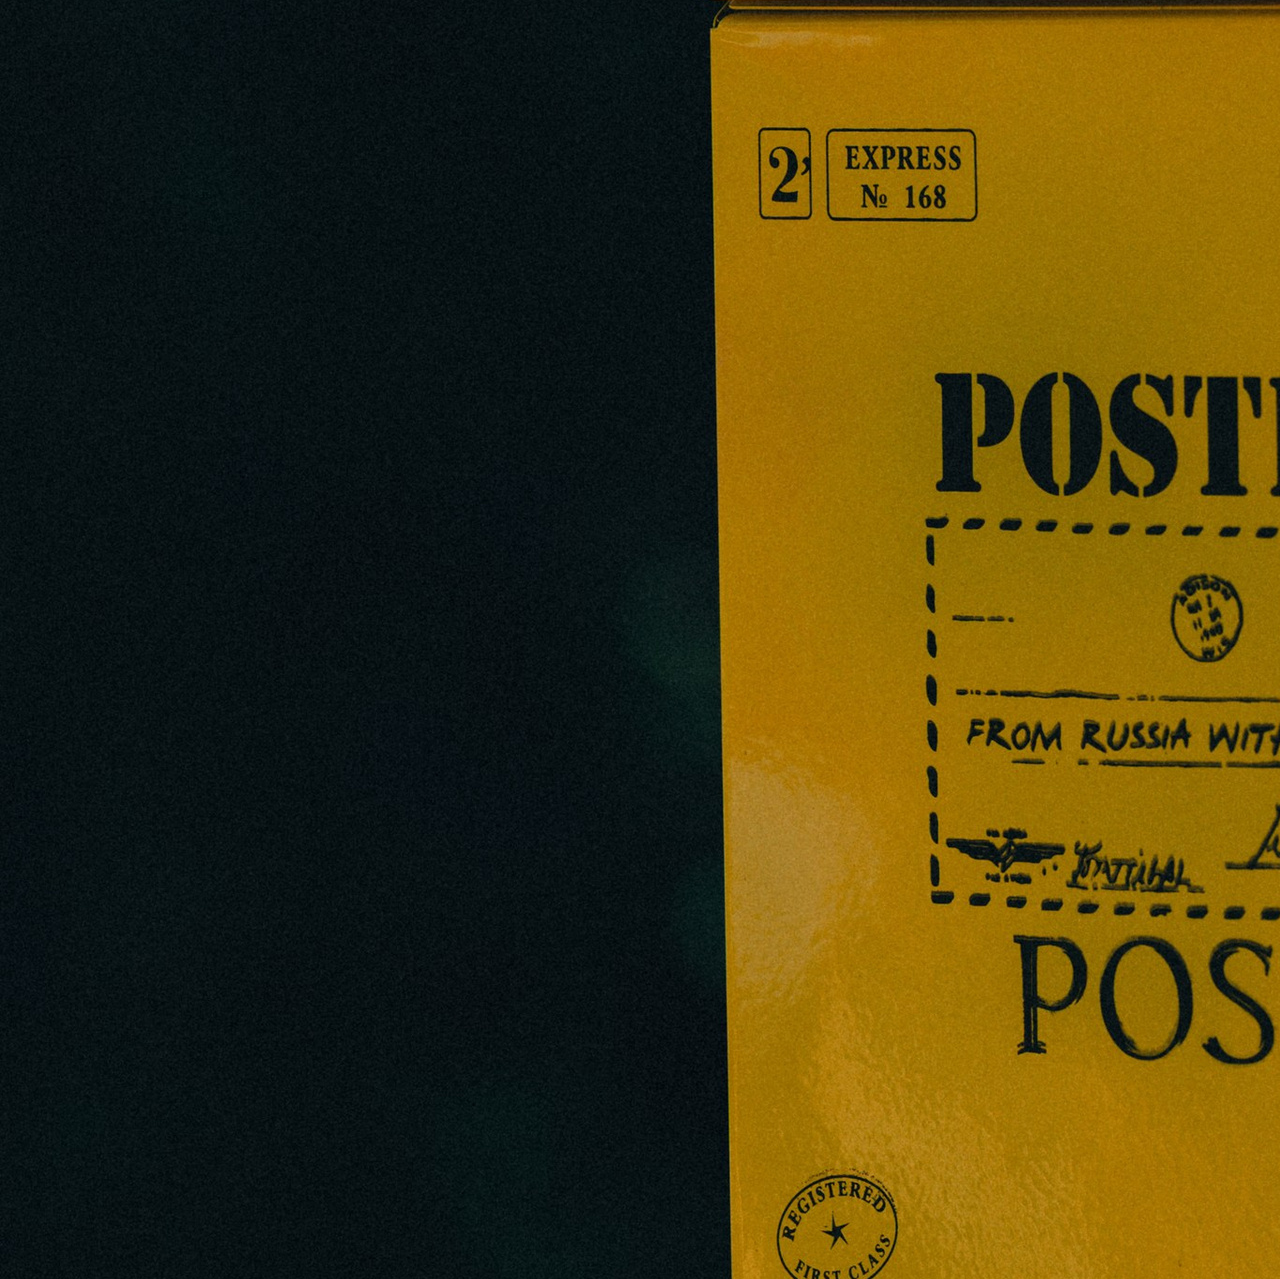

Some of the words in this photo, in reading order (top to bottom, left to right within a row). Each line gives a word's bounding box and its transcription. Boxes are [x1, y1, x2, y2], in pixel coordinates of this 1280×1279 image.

[845, 145, 962, 171] EXPRESS
[905, 184, 947, 209] 168
[966, 717, 1063, 752] FROM
[1080, 717, 1192, 754] RUSSIA
[782, 1180, 887, 1242] REGISTERED
